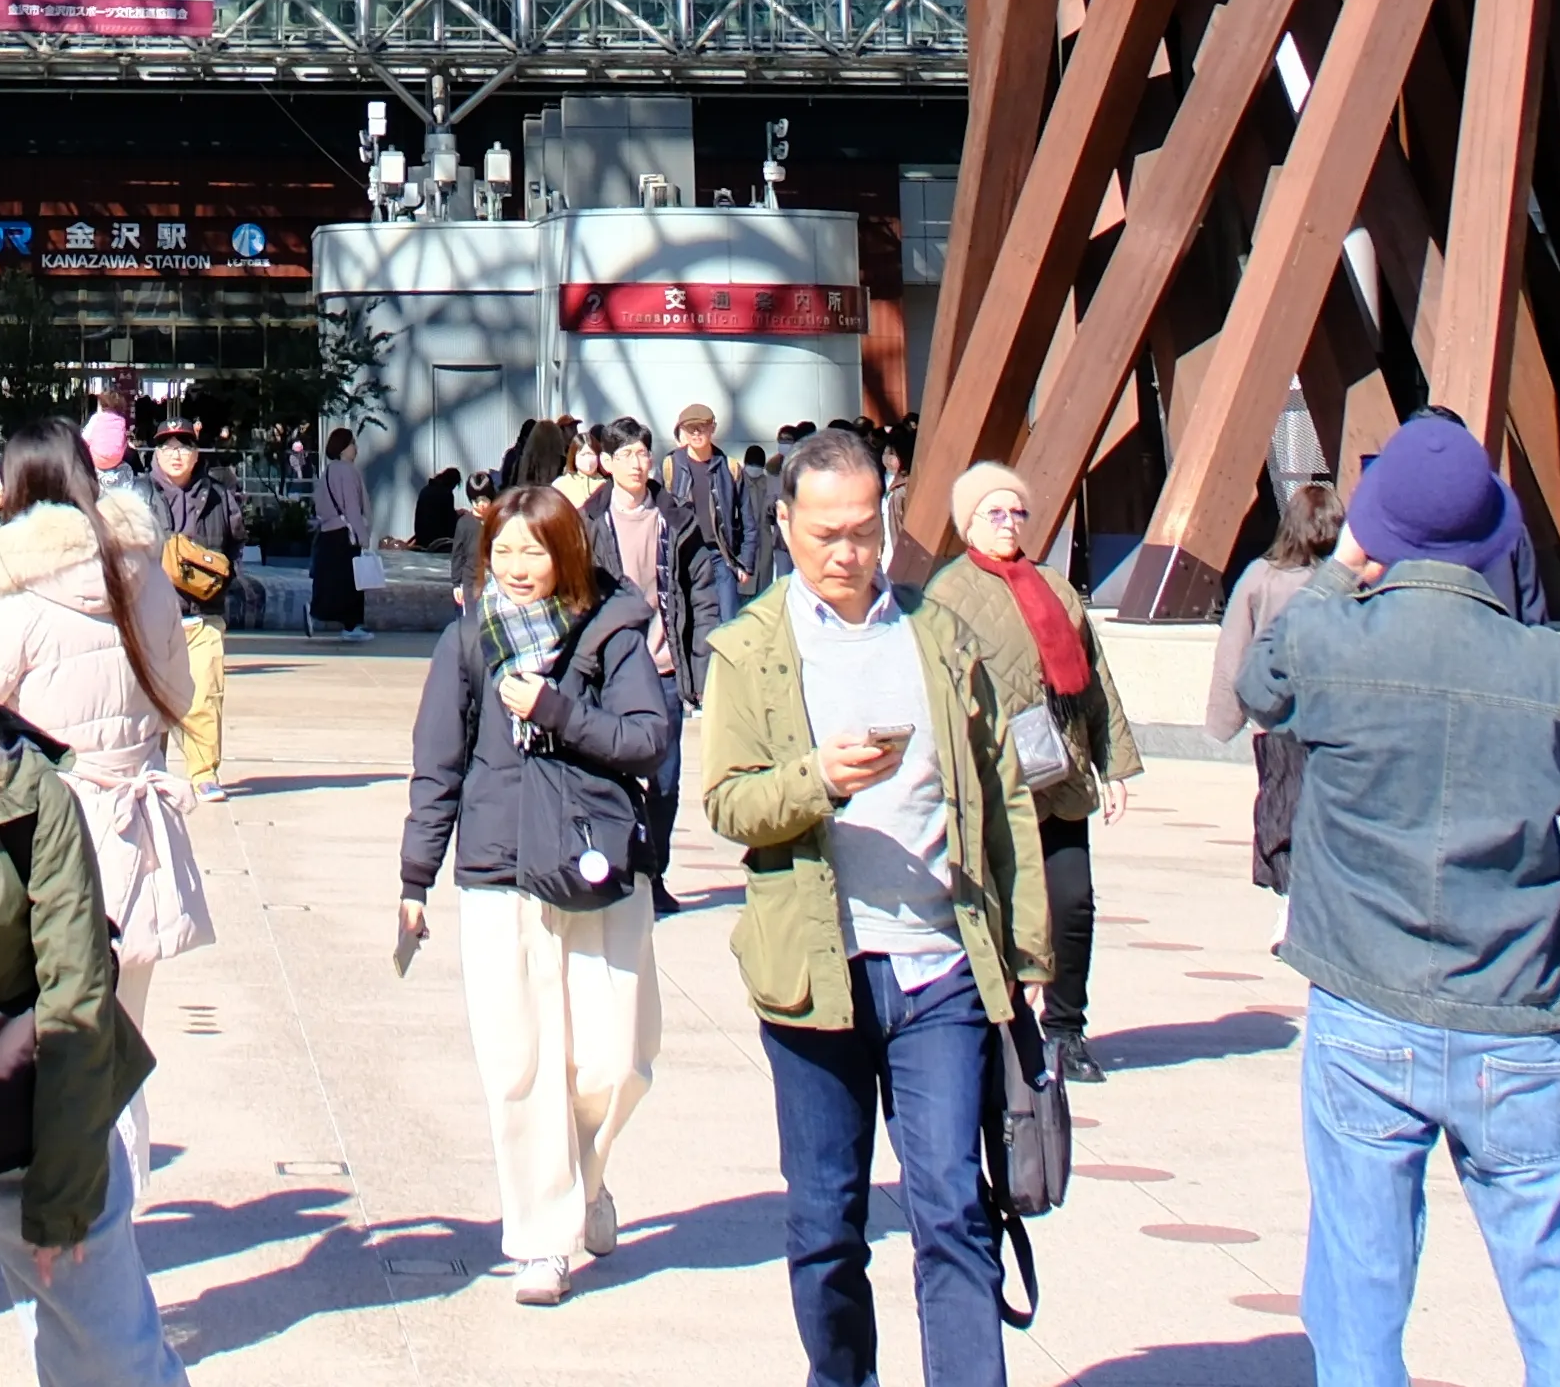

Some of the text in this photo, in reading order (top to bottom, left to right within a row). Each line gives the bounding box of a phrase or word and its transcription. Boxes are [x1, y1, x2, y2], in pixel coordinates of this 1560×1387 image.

[66, 221, 187, 250] 金沢駅
[41, 254, 139, 270] KANAZAWA
[144, 254, 211, 270] STATION
[664, 286, 844, 313] 交通案内所
[621, 310, 738, 326] Transportation
